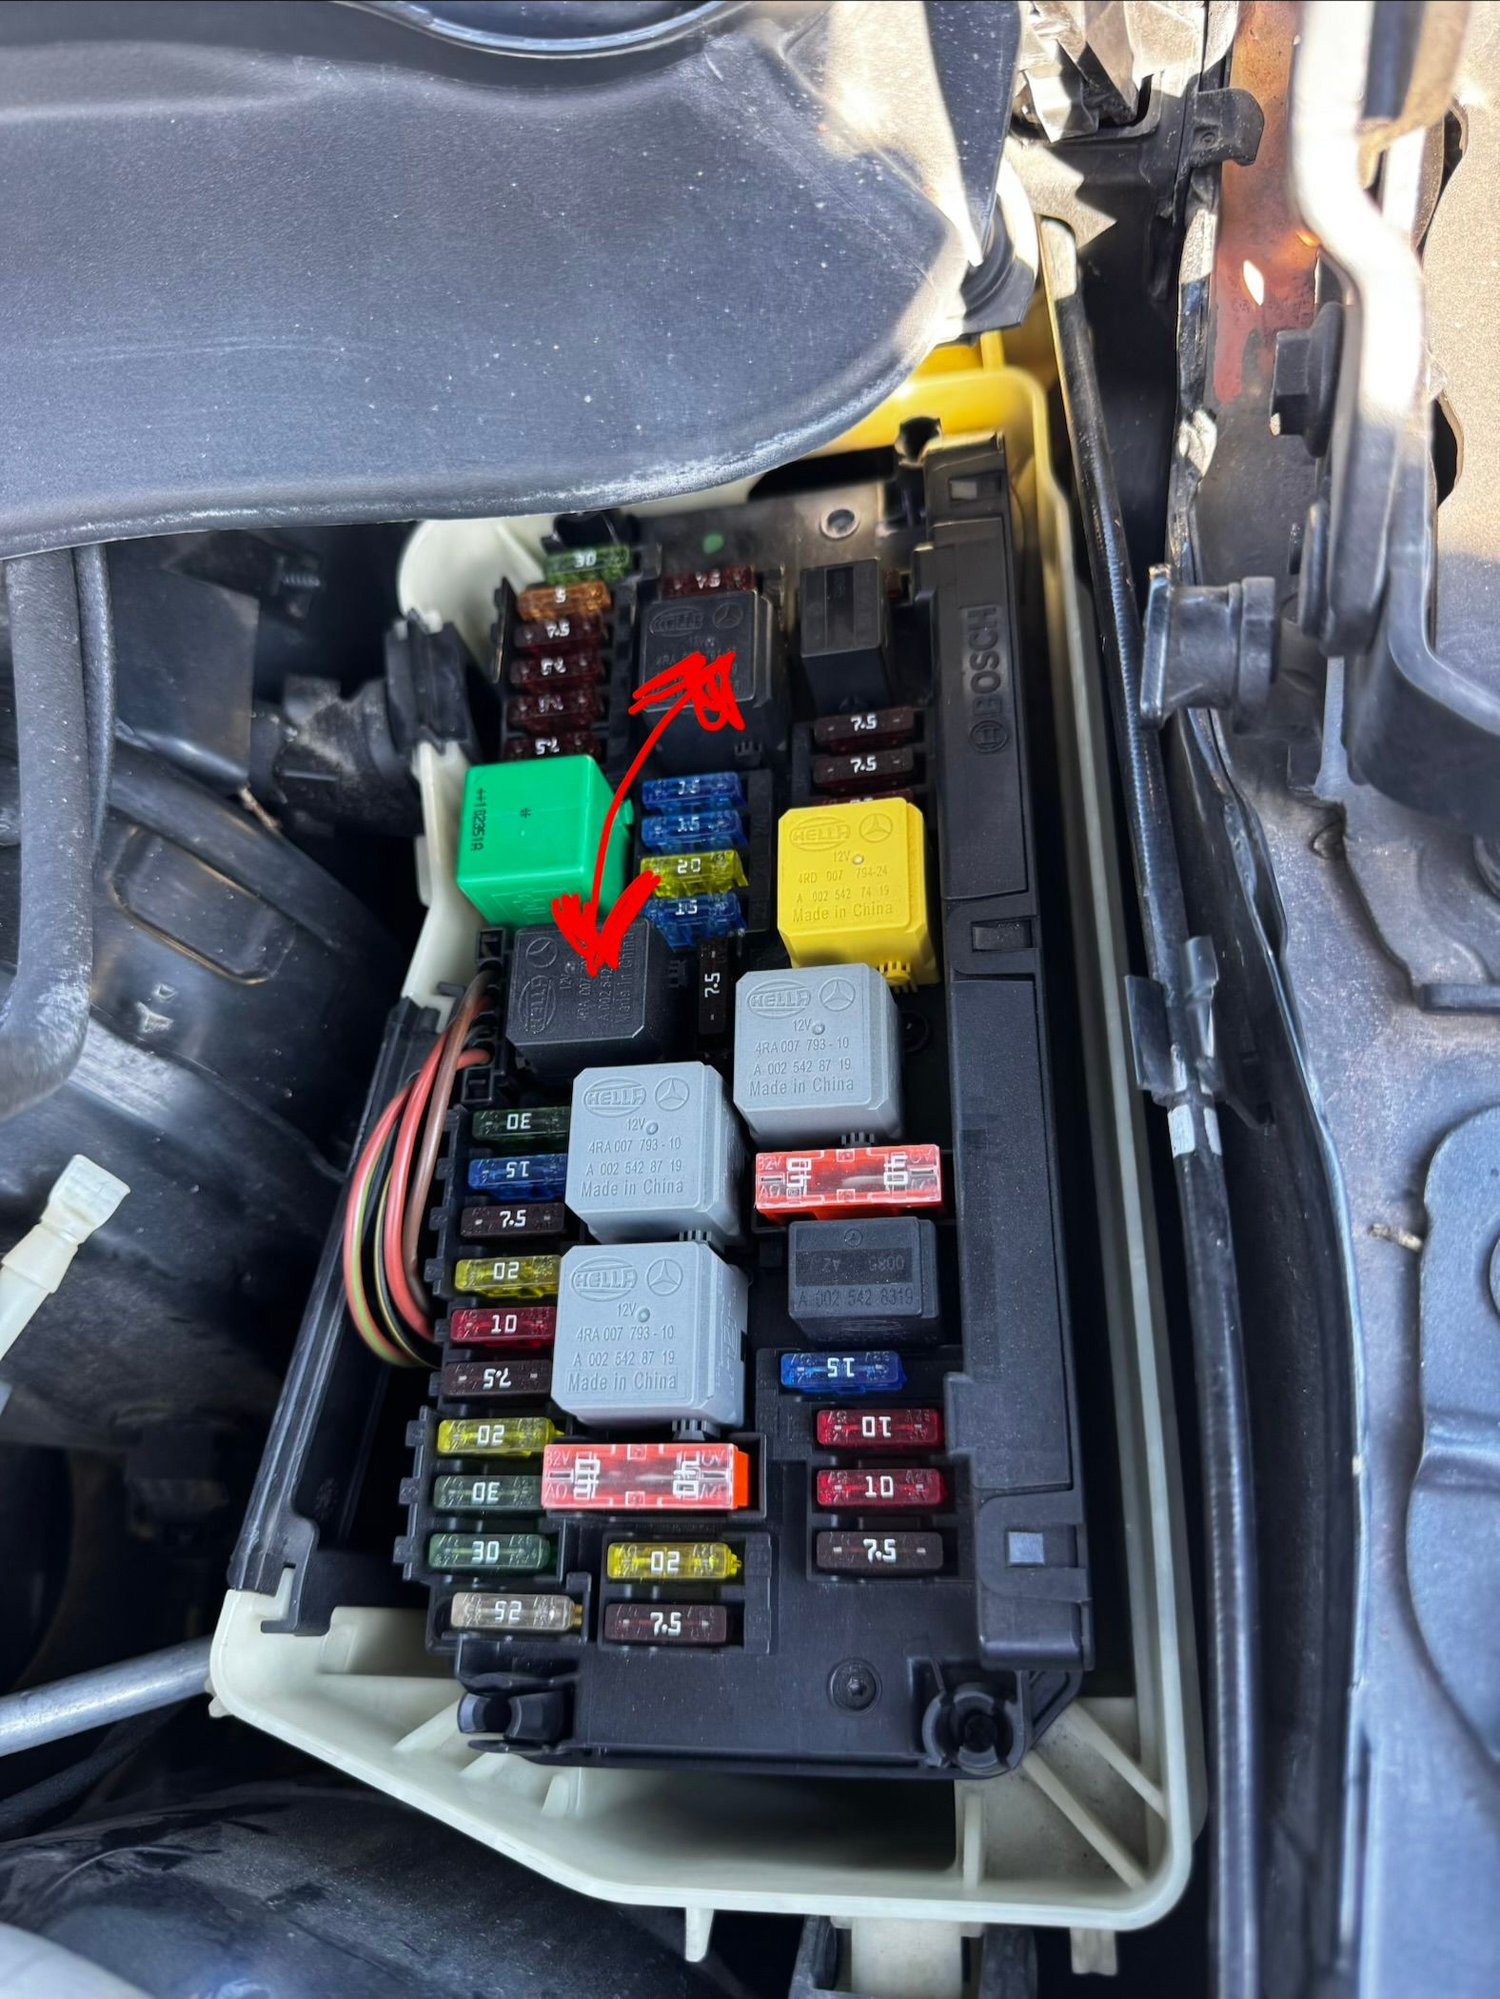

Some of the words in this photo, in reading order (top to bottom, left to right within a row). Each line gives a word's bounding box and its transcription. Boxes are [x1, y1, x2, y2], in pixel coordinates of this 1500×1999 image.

[574, 551, 596, 568] 30
[555, 587, 567, 603] 5
[546, 618, 570, 638] 7.5
[541, 656, 567, 676] 7.5
[967, 606, 1003, 716] BOSCH
[850, 714, 877, 731] 7.5
[535, 736, 560, 755] 7.5
[850, 755, 877, 773] 7.5
[677, 779, 700, 795] 15
[677, 817, 700, 832] 15
[793, 824, 850, 842] HELLA
[677, 858, 701, 874] 20
[833, 851, 850, 862] 12V
[826, 870, 843, 881] 007
[796, 892, 803, 903] A
[812, 890, 828, 902] 002
[835, 888, 851, 900] 542
[861, 886, 871, 897] 74
[880, 884, 889, 896] 19
[675, 900, 698, 916] 15
[793, 906, 829, 922] Made
[835, 905, 846, 918] in
[853, 901, 893, 917] China
[704, 972, 720, 998] 7.5
[751, 989, 810, 1007] HELLA
[792, 1018, 811, 1031] 12V
[755, 1041, 778, 1055] 4RA
[781, 1039, 800, 1053] 007
[807, 1038, 826, 1051] 793
[837, 1037, 849, 1049] 10
[754, 1064, 762, 1076] A
[768, 1062, 787, 1075] 002
[793, 1060, 812, 1073] 542
[819, 1059, 831, 1072] 87
[840, 1058, 851, 1070] 19
[750, 1080, 787, 1096] Made
[794, 1078, 805, 1093] in
[813, 1077, 854, 1092] China
[587, 1087, 646, 1106] HELLA
[506, 1113, 532, 1130] 30
[627, 1118, 645, 1131] 12V
[589, 1141, 611, 1154] 4RA
[614, 1139, 632, 1153] 007
[640, 1138, 658, 1151] 793
[670, 1137, 681, 1149] 10
[506, 1161, 530, 1178] 15
[586, 1164, 594, 1176] A
[600, 1162, 619, 1175] 002
[625, 1161, 644, 1174] 542
[650, 1160, 663, 1173] 87
[671, 1159, 682, 1172] 19
[581, 1181, 617, 1198] Made
[624, 1179, 636, 1195] in
[643, 1178, 683, 1194] China
[500, 1209, 527, 1229] 7.5
[492, 1261, 519, 1280] 20
[576, 1270, 636, 1288] HELLA
[617, 1303, 636, 1317] 12V
[491, 1314, 518, 1333] 10
[576, 1327, 599, 1342] 4RA
[603, 1326, 623, 1340] 007
[630, 1326, 650, 1340] 793
[662, 1325, 674, 1339] 10
[573, 1353, 581, 1366] A
[589, 1352, 608, 1366] 002
[615, 1352, 634, 1366] 542
[641, 1351, 654, 1365] 87
[663, 1350, 675, 1364] 19
[827, 1358, 855, 1378] 15
[482, 1367, 512, 1390] 7.5
[568, 1373, 607, 1391] Made
[614, 1372, 626, 1390] in
[634, 1371, 677, 1389] China
[477, 1425, 504, 1445] 20
[861, 1416, 892, 1438] 10
[472, 1482, 500, 1504] 30
[865, 1475, 894, 1498] 10
[471, 1540, 500, 1564] 30
[863, 1539, 897, 1563] 7.5
[651, 1551, 680, 1574] 20
[495, 1601, 522, 1622] 25
[650, 1612, 681, 1636] 7.5
